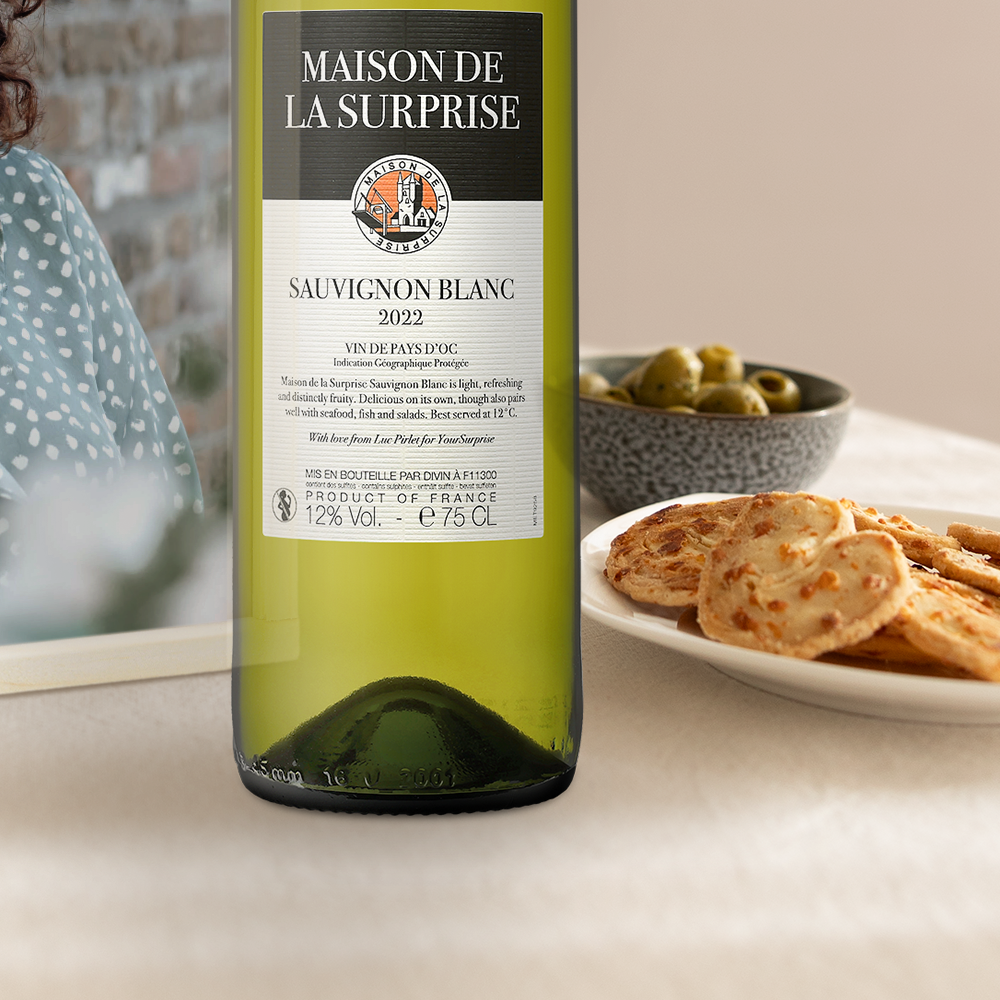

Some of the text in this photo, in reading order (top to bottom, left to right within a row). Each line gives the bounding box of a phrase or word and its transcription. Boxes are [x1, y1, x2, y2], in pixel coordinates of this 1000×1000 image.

[301, 49, 504, 84] MAISON DE
[284, 93, 520, 130] LA SURPRISE
[364, 161, 446, 251] MAISON DE LA SURPRISE
[289, 277, 515, 301] SAUVIGNON BLANC
[378, 308, 424, 326] 2022
[345, 342, 366, 354] VIN
[369, 342, 388, 355] DE
[390, 342, 422, 355] PAYS
[333, 357, 469, 371] Indication Géographique Protégée
[281, 376, 523, 392] Maison de la Surprise Sauvignon Blanc is light, refreshing
[278, 392, 525, 406] and distinctly fruity. Delicious on its own, though also pairs
[285, 407, 300, 416] well
[301, 408, 319, 417] with
[320, 408, 356, 419] seafood,
[359, 409, 375, 419] fish
[377, 409, 394, 419] and
[397, 409, 427, 419] salads.
[431, 409, 451, 419] Best
[453, 408, 481, 418] served
[482, 410, 490, 418] at
[309, 432, 495, 447] With love from Luc Pirlet for YourSurprise
[305, 469, 497, 480] MIS EN BOUTEILLE PAR DIVIN À F11300
[306, 490, 497, 504] PRODUCT OF FRANCE
[306, 504, 343, 527] 12%
[348, 505, 381, 527] Vol.
[442, 506, 466, 528] 75
[471, 504, 498, 527] CL
